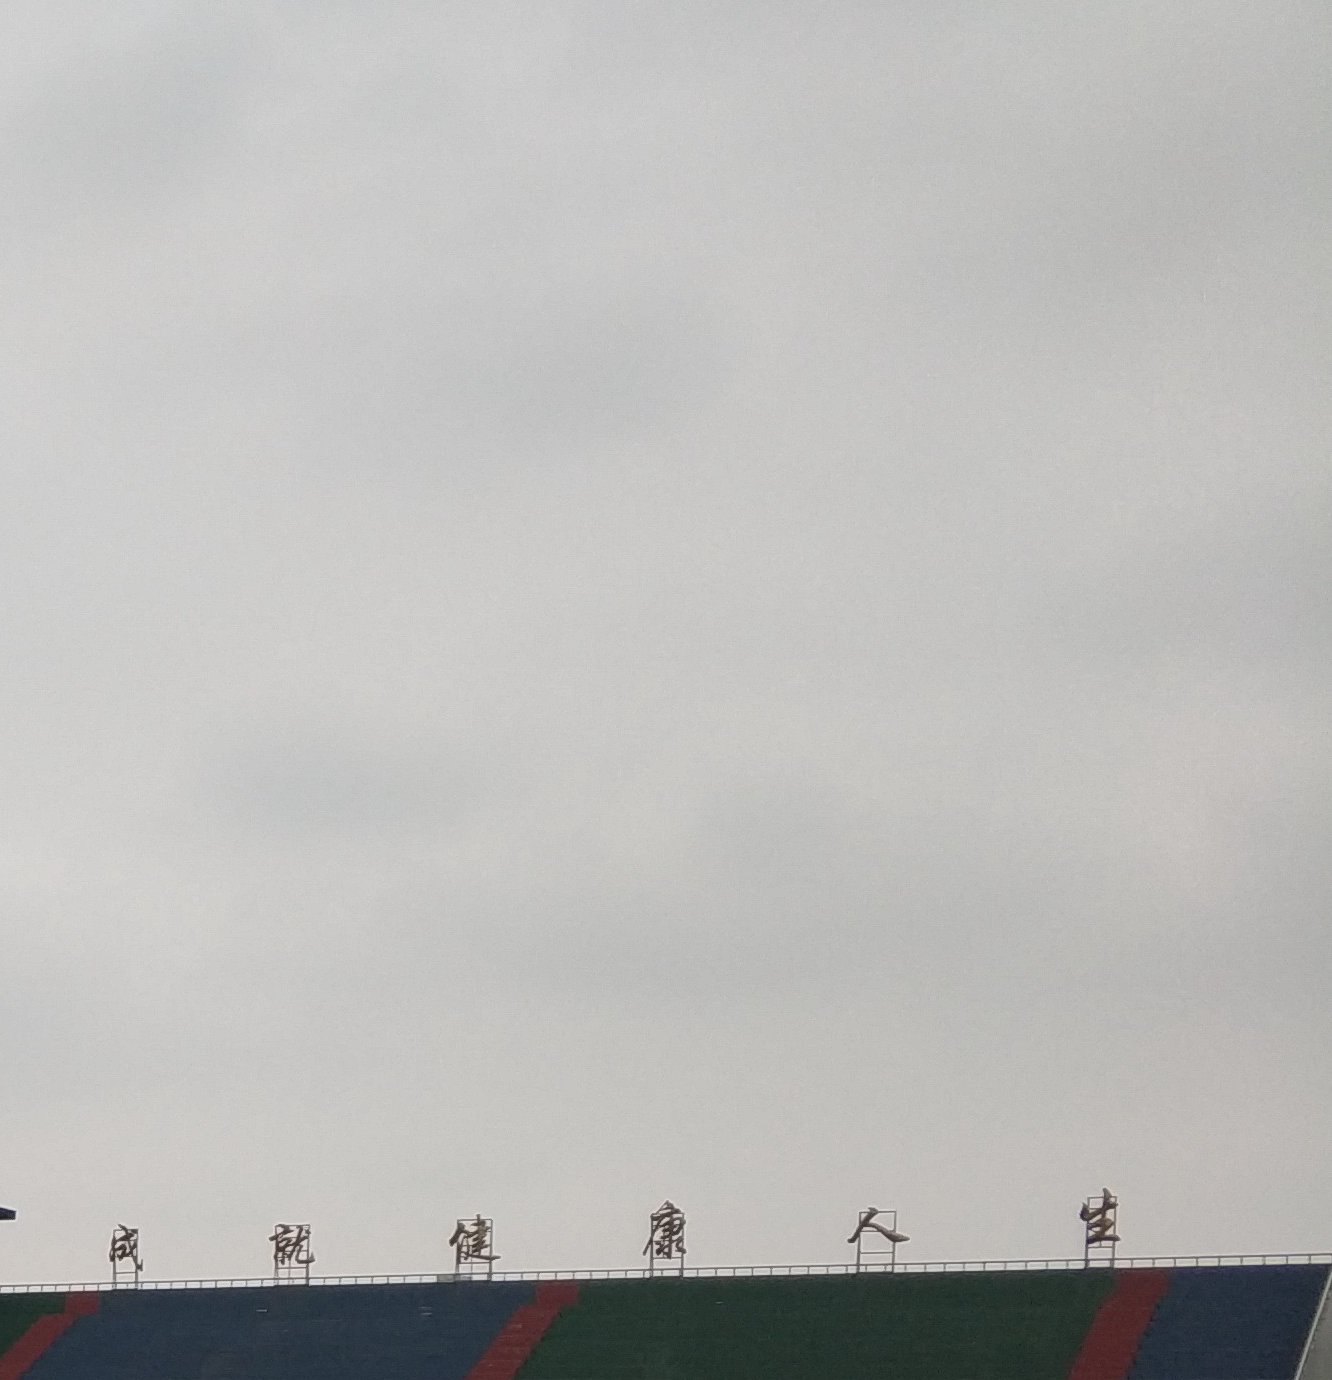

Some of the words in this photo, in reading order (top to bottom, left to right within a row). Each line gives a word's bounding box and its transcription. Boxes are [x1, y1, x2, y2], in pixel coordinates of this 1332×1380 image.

[109, 1188, 1122, 1271] 成就健康人生
